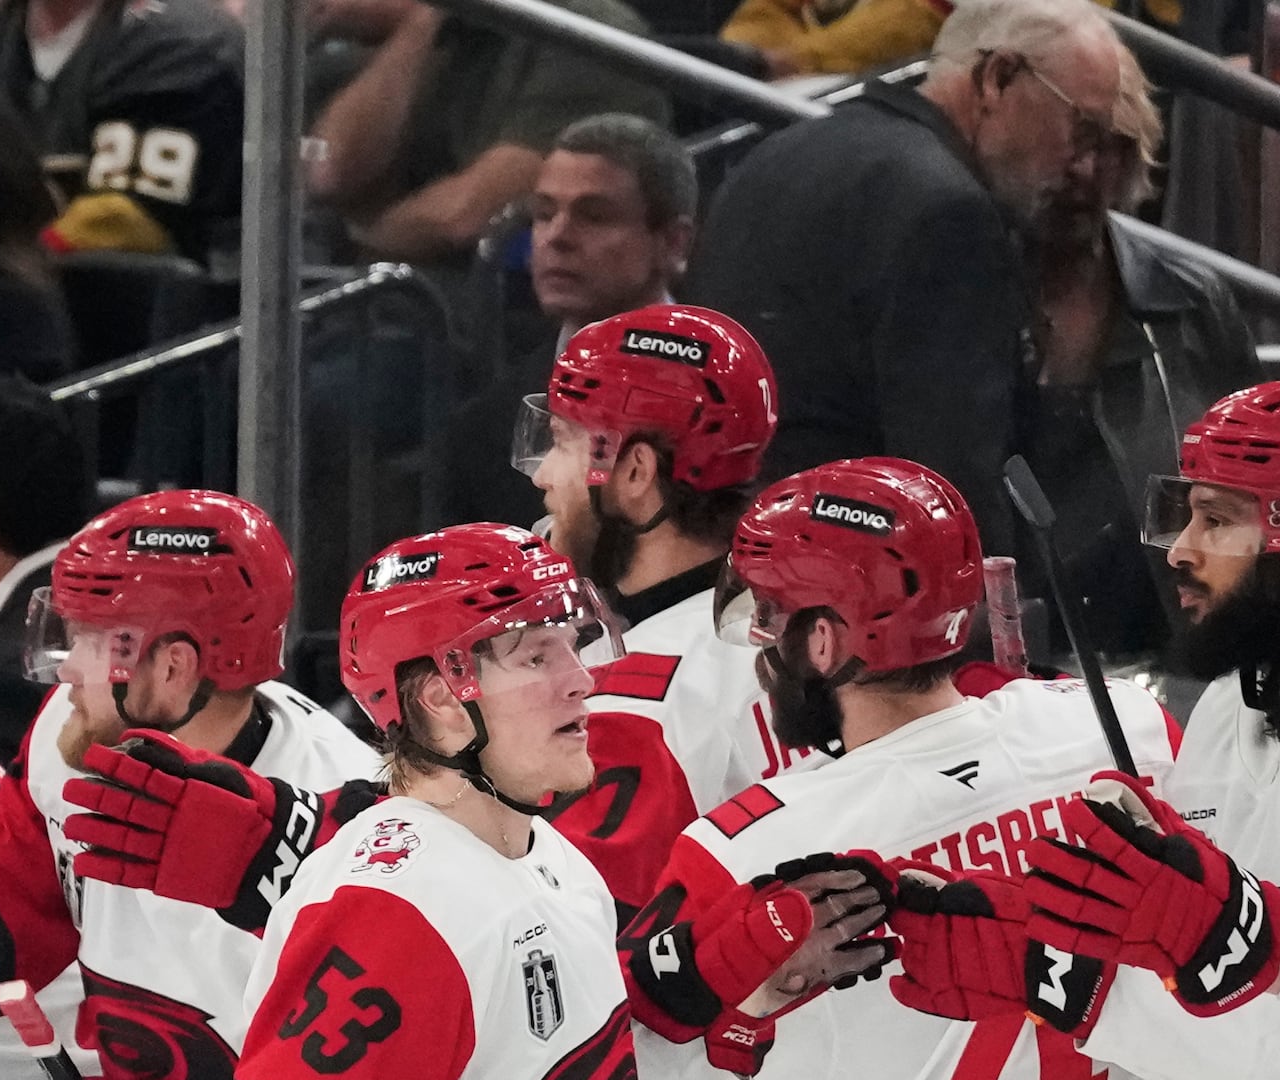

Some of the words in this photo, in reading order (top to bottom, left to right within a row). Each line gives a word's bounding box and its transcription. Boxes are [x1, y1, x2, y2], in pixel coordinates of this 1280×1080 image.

[87, 121, 199, 203] 29
[626, 330, 703, 360] Lenovo
[814, 497, 890, 530] Lenovo
[134, 529, 210, 550] Lenovo
[533, 561, 569, 581] CCM
[256, 786, 319, 908] CM
[765, 900, 794, 943] CCM
[277, 945, 403, 1075] 53
